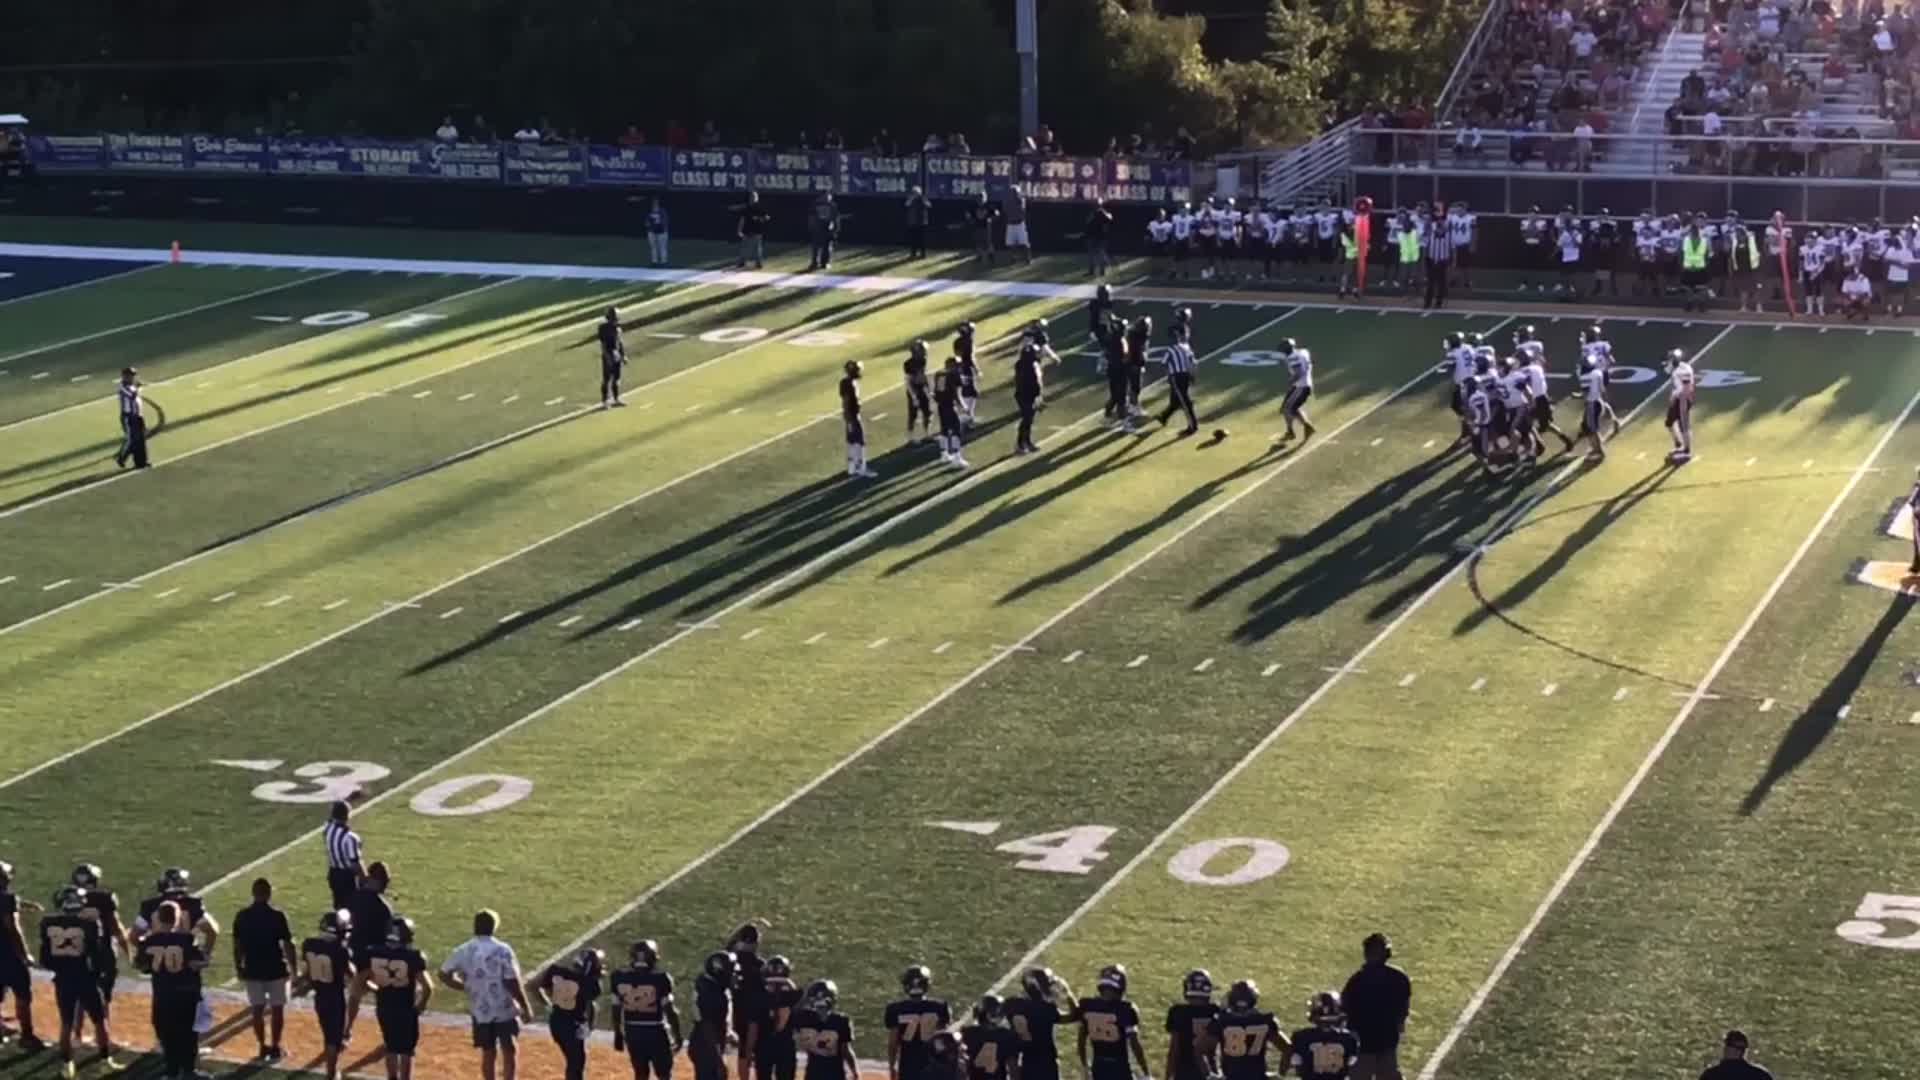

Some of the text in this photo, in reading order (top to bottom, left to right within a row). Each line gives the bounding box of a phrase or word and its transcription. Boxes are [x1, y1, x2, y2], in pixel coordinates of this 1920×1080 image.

[928, 158, 969, 174] CLASS
[672, 171, 710, 186] CLASS
[713, 172, 727, 187] OF
[754, 174, 794, 188] CLASS
[147, 945, 184, 973] 70
[1223, 1024, 1269, 1057] 87
